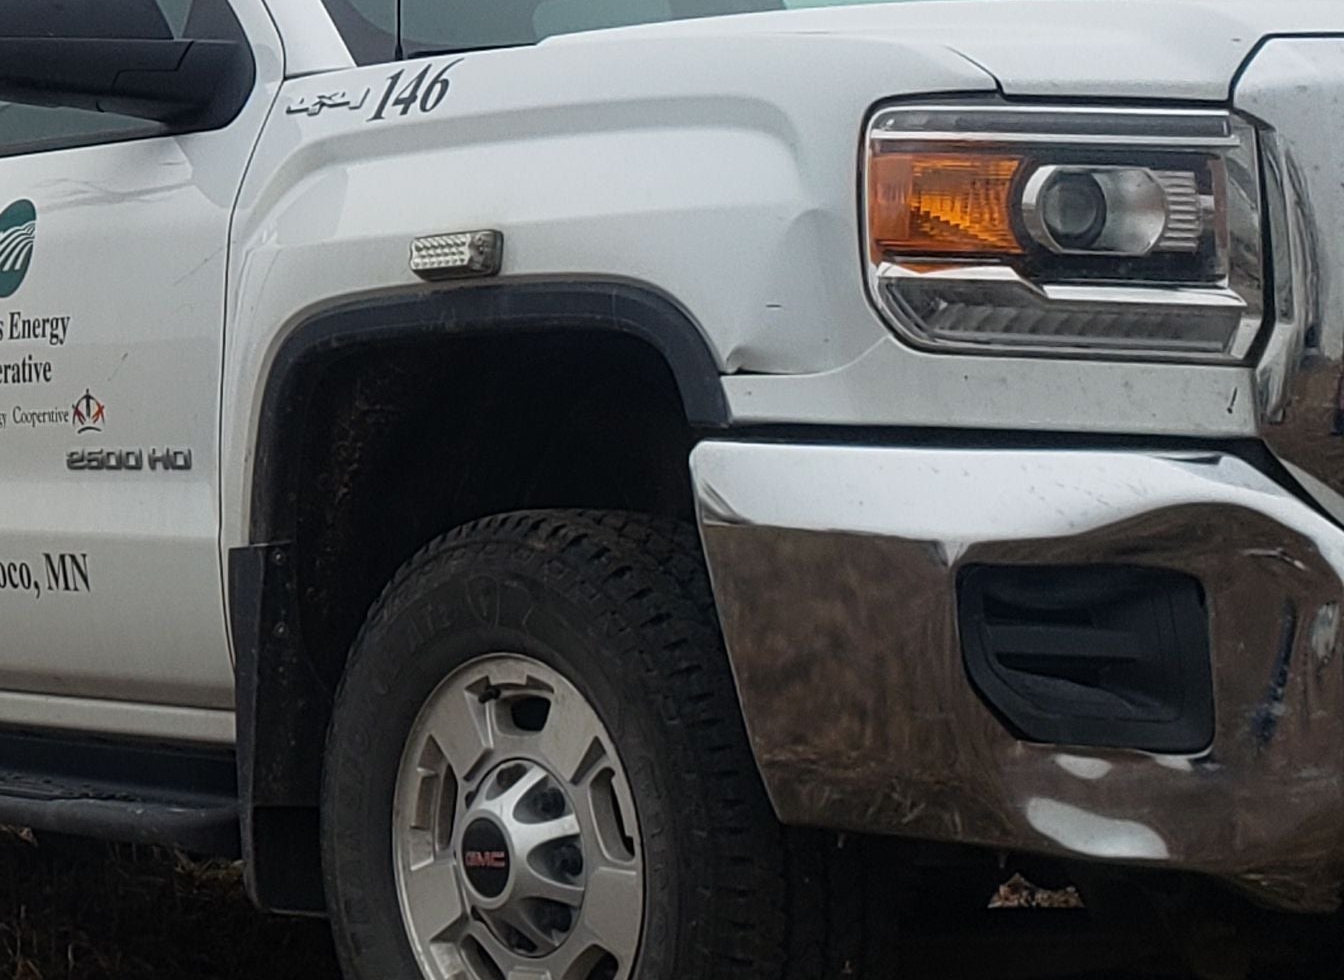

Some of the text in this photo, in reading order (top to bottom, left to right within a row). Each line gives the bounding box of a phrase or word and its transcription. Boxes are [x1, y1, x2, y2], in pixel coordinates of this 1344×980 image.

[365, 57, 465, 122] 146
[8, 311, 71, 346] Energy
[12, 405, 70, 427] Cooperative
[66, 447, 192, 471] 2500 HD
[42, 553, 91, 593] MN
[464, 850, 505, 867] GMC
